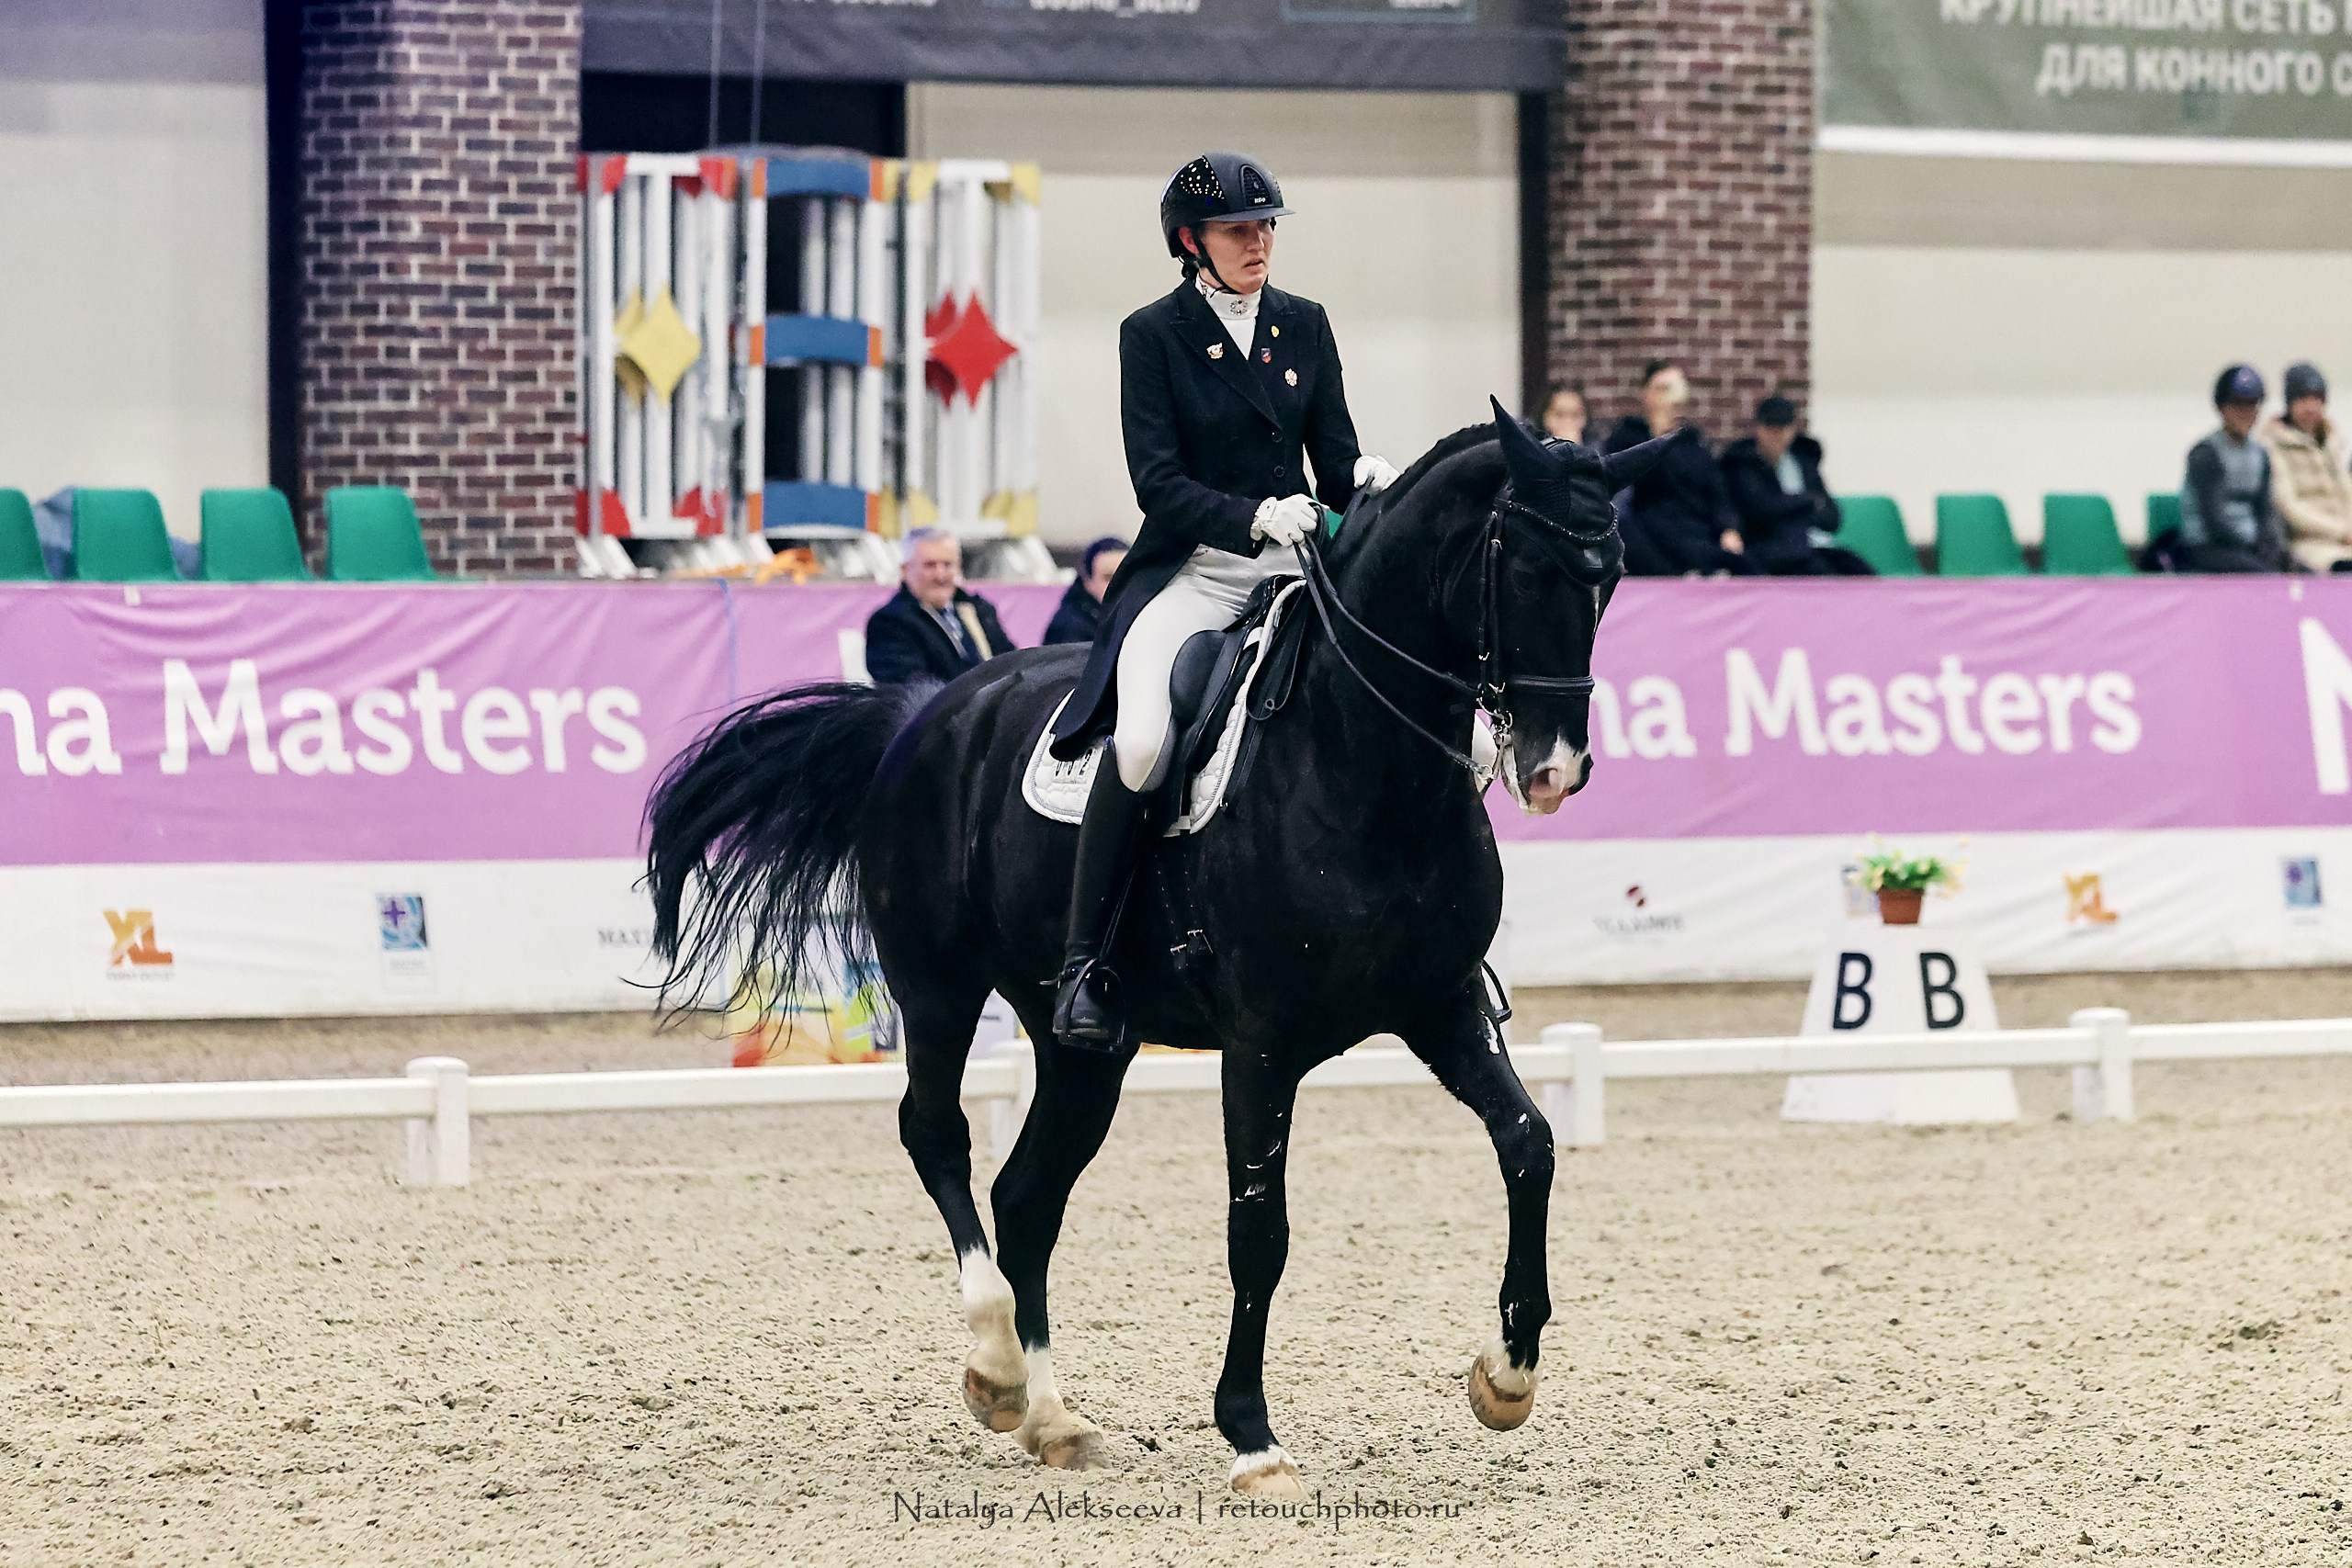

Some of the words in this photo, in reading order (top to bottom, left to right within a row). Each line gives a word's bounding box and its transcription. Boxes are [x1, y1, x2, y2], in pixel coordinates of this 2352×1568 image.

[2036, 44, 2127, 96] ДЛЯ
[2133, 46, 2324, 96] КОННОГО
[159, 658, 649, 776] Masters
[1724, 646, 2143, 758] Masters
[1832, 952, 1873, 1030] B
[1918, 952, 1965, 1030] B
